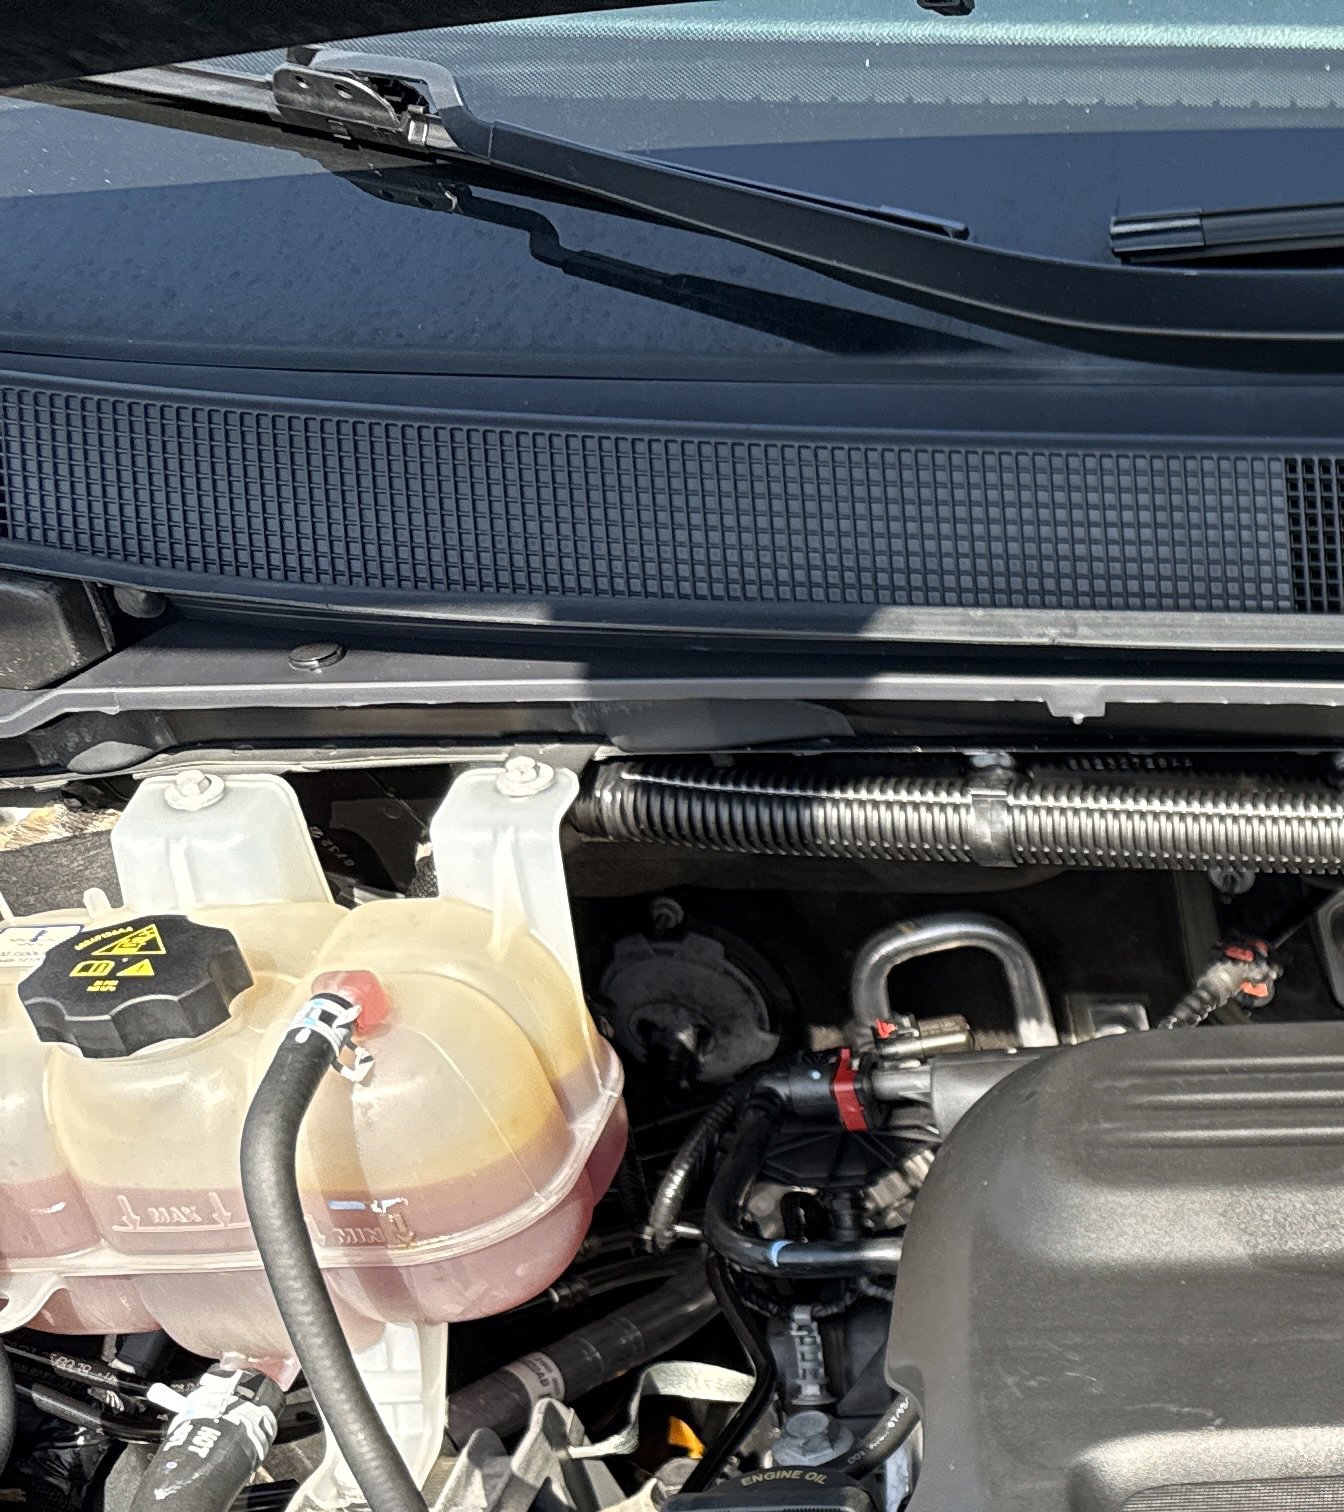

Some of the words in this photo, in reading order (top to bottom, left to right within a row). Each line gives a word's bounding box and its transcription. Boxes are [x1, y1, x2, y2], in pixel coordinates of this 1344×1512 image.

[149, 1205, 201, 1226] MAX
[331, 1226, 386, 1245] MIN
[740, 1469, 803, 1487] ENGINE
[804, 1471, 828, 1485] OIL
